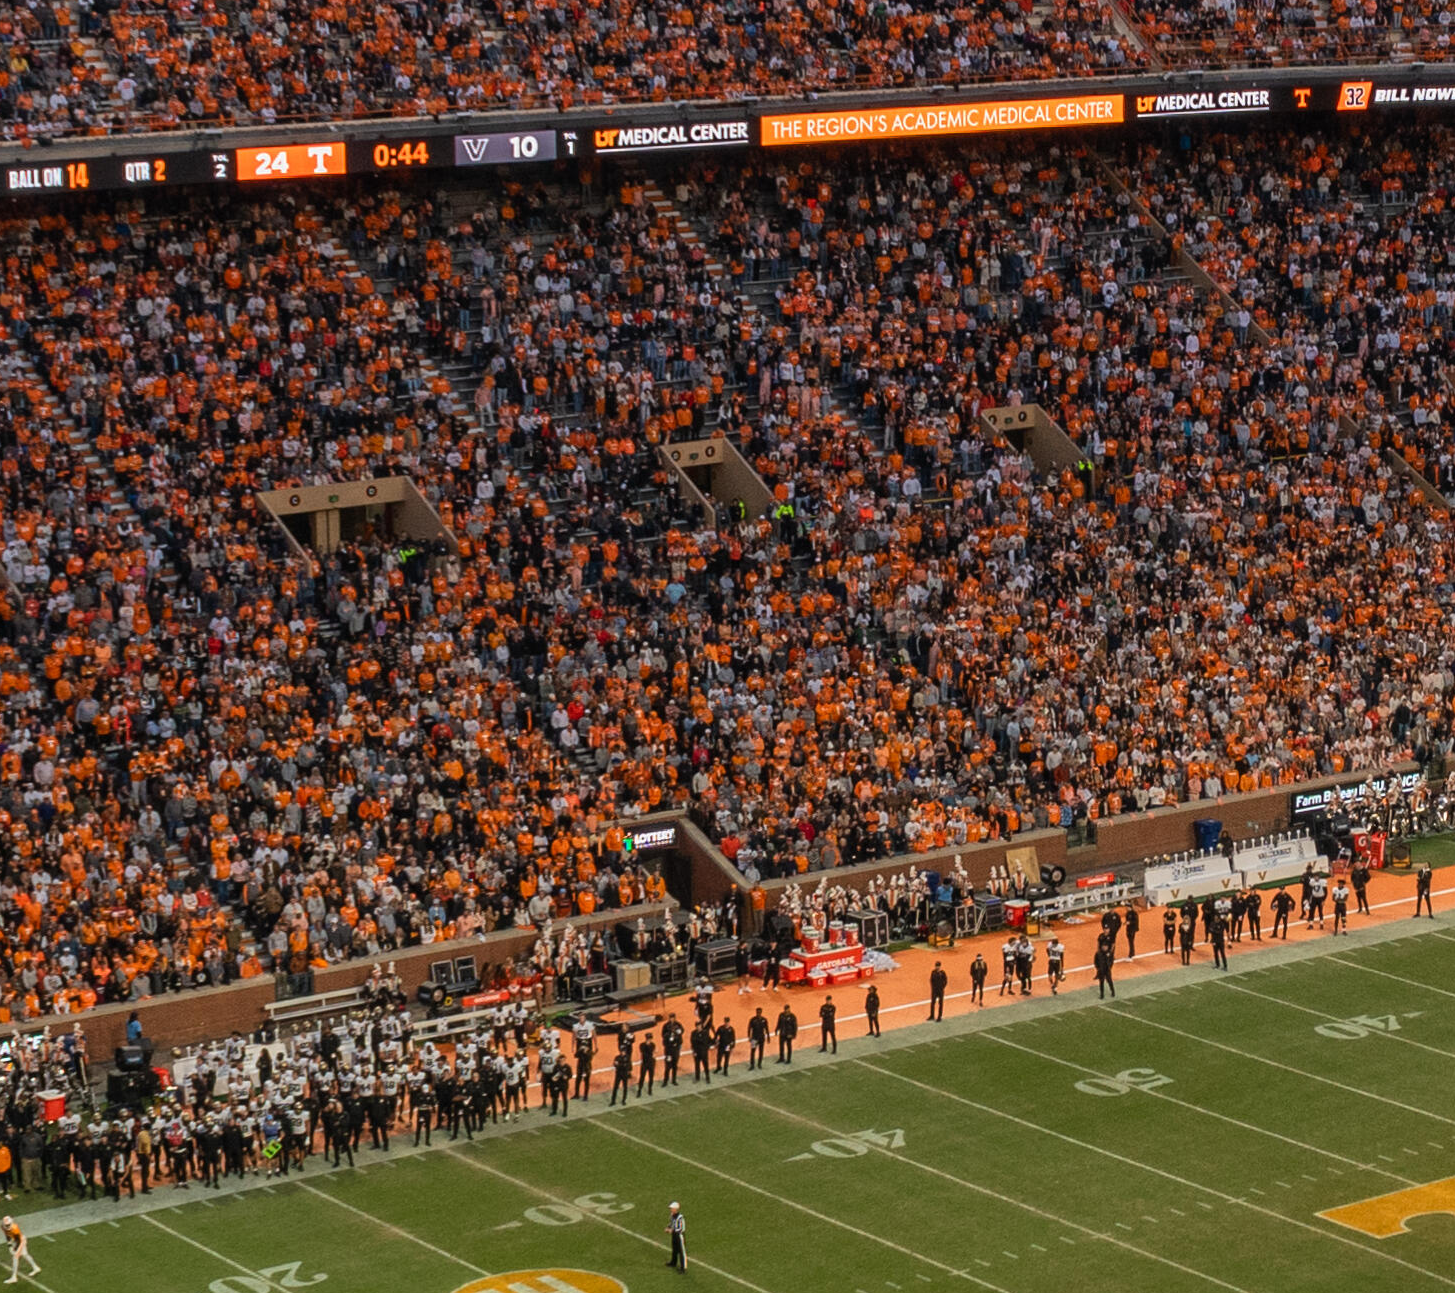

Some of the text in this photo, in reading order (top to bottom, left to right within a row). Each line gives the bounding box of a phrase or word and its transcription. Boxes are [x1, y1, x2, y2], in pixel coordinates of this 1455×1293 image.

[1155, 91, 1269, 112] MEDICAL CENTER
[1345, 86, 1364, 106] 32
[1374, 89, 1410, 103] BILL
[772, 101, 1113, 139] THE REGION'S ACADEMIC MEDICAL CENTER
[617, 123, 749, 147] MEDICAL CENTER
[374, 142, 429, 168] 0:44
[510, 137, 538, 159] 10
[566, 141, 575, 155] 1
[215, 164, 227, 178] 2
[255, 151, 290, 175] 24
[8, 169, 40, 190] BALL
[44, 167, 63, 187] ON
[67, 163, 89, 189] 14
[125, 162, 150, 183] QTR
[154, 160, 167, 182] 2
[1296, 794, 1323, 809] Farm
[634, 828, 675, 845] LOTTERY
